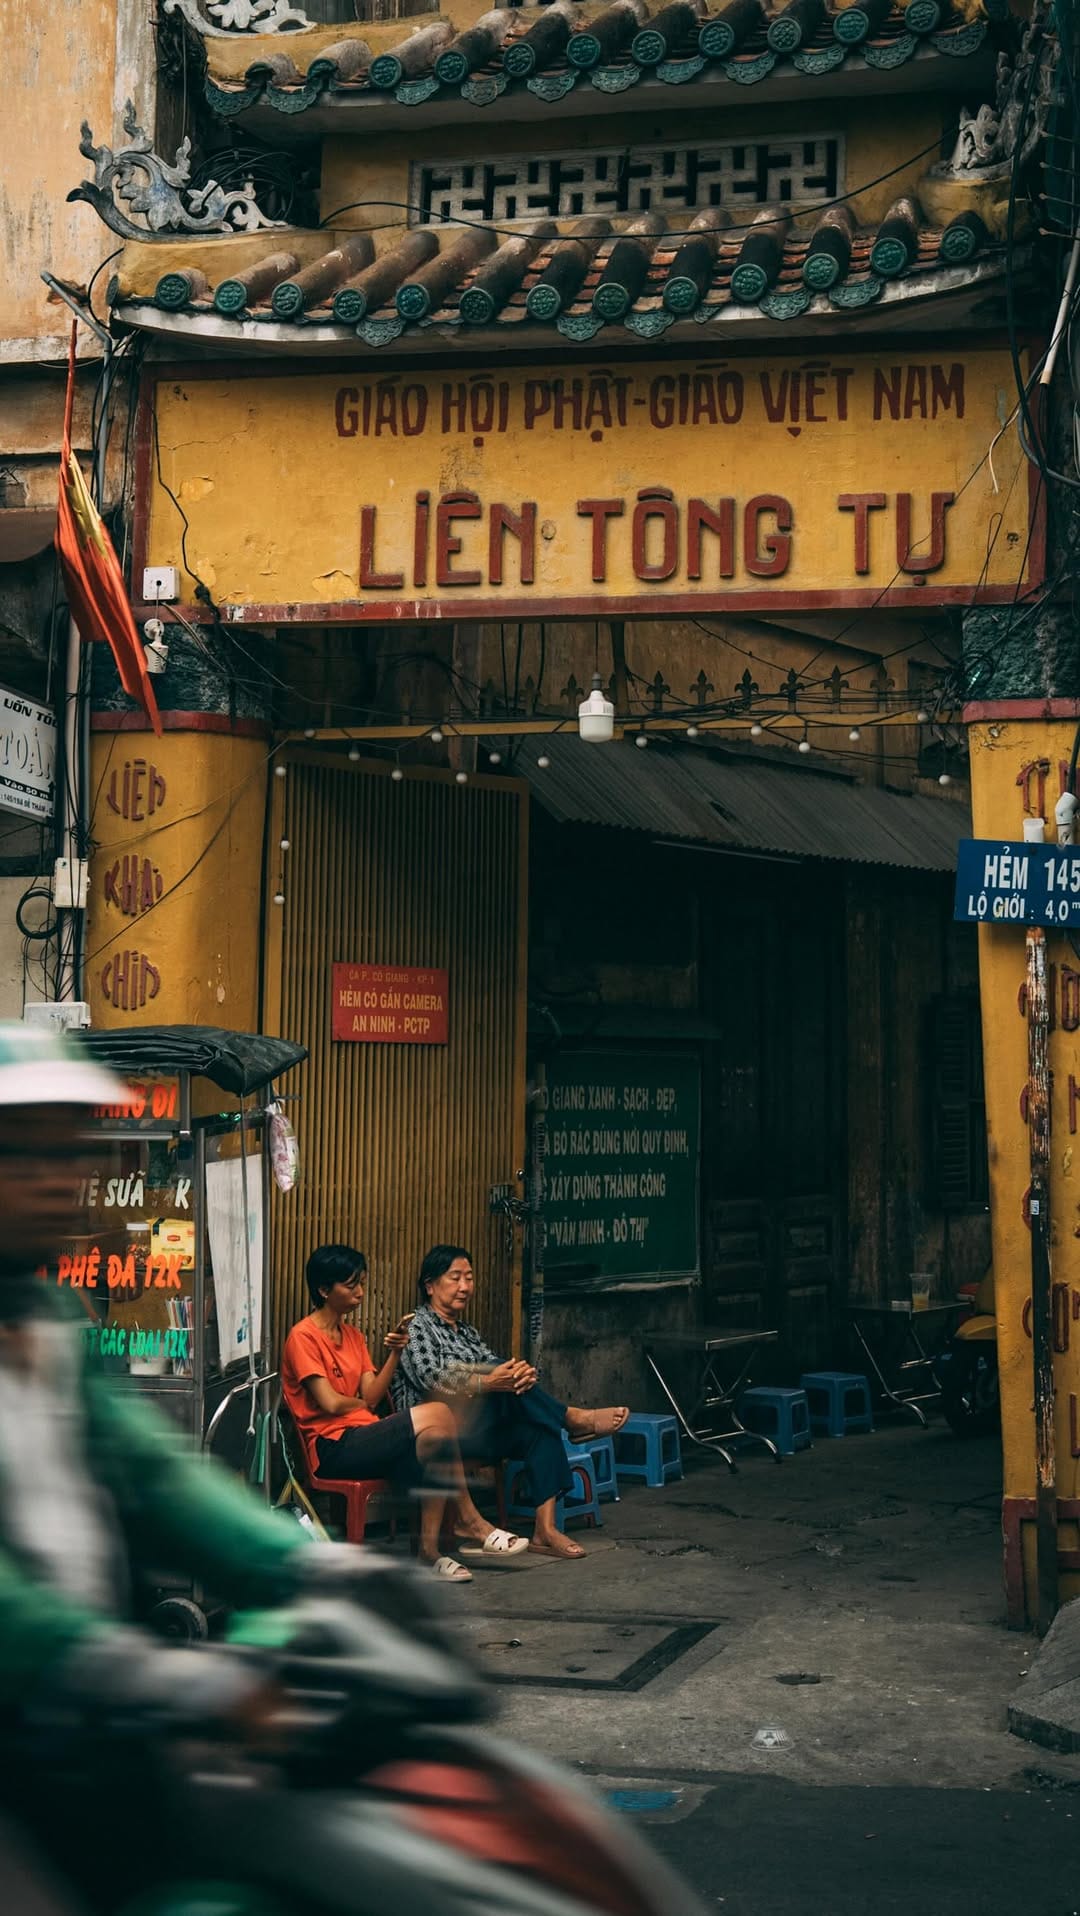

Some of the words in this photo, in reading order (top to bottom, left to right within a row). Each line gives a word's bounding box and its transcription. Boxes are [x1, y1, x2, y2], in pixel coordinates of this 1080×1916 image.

[335, 375, 428, 437] GIÁO
[441, 373, 509, 448] HỘI
[759, 361, 854, 438] VIỆT
[873, 362, 965, 421] NAM
[577, 487, 793, 583] TÔNG
[838, 491, 956, 587] TỰ
[4, 697, 32, 717] UỐN
[983, 845, 1029, 890] HẺM
[967, 891, 987, 920] LỘ
[993, 891, 1025, 919] GIỚI
[403, 993, 443, 1011] CAMERA
[352, 1015, 367, 1032] AN
[370, 1015, 395, 1033] NINH
[404, 1017, 430, 1035] PCTP
[553, 1085, 586, 1111] GIANG
[588, 1086, 616, 1111] XANH
[624, 1086, 649, 1118] SẠCH
[570, 1123, 591, 1155] RÁC
[593, 1123, 621, 1154] ĐÚNG
[642, 1129, 661, 1154] QUY
[639, 1168, 666, 1198] CÔNG
[578, 1217, 605, 1246] MINH
[57, 1246, 101, 1289] PHÊ
[145, 1254, 182, 1289] 12K
[164, 1328, 188, 1360] 12K
